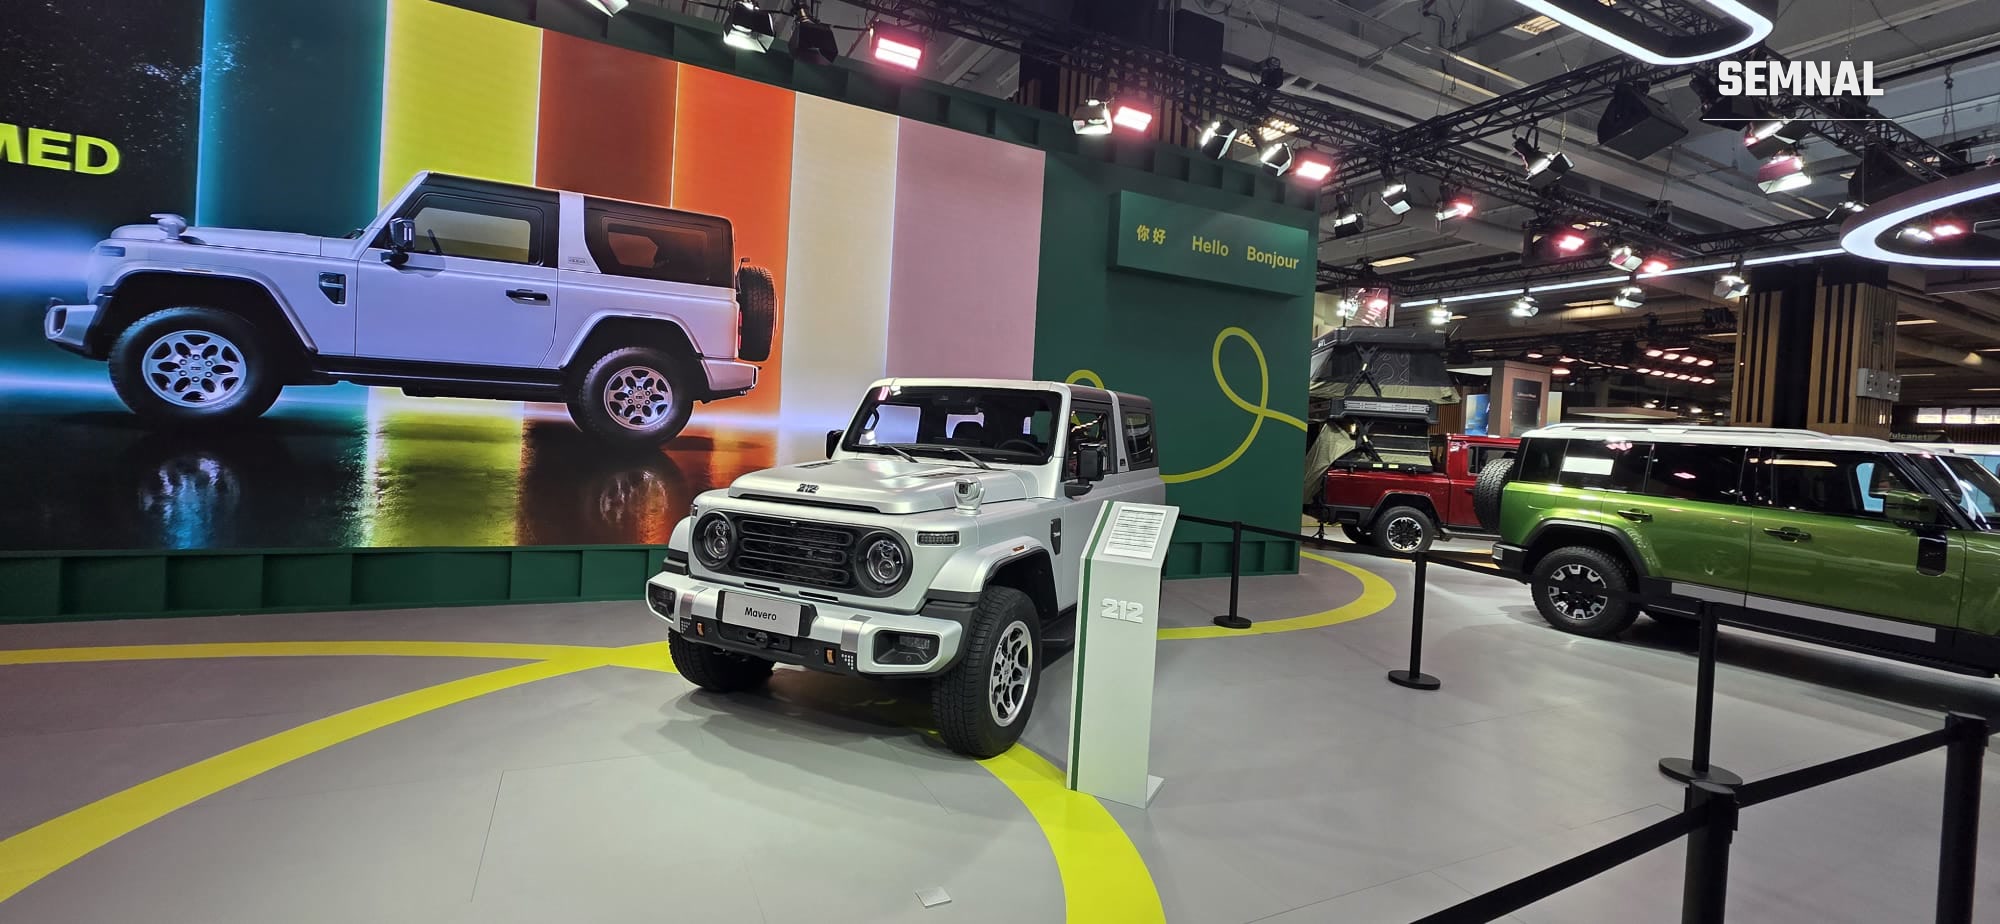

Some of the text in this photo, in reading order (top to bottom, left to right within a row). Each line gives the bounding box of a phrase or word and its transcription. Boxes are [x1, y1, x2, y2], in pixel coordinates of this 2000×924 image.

[1136, 224, 1167, 245] 你好
[1191, 235, 1300, 269] Hello Bonjour
[796, 483, 819, 494] 212
[744, 607, 777, 621] Mavero
[1101, 598, 1144, 624] 212
